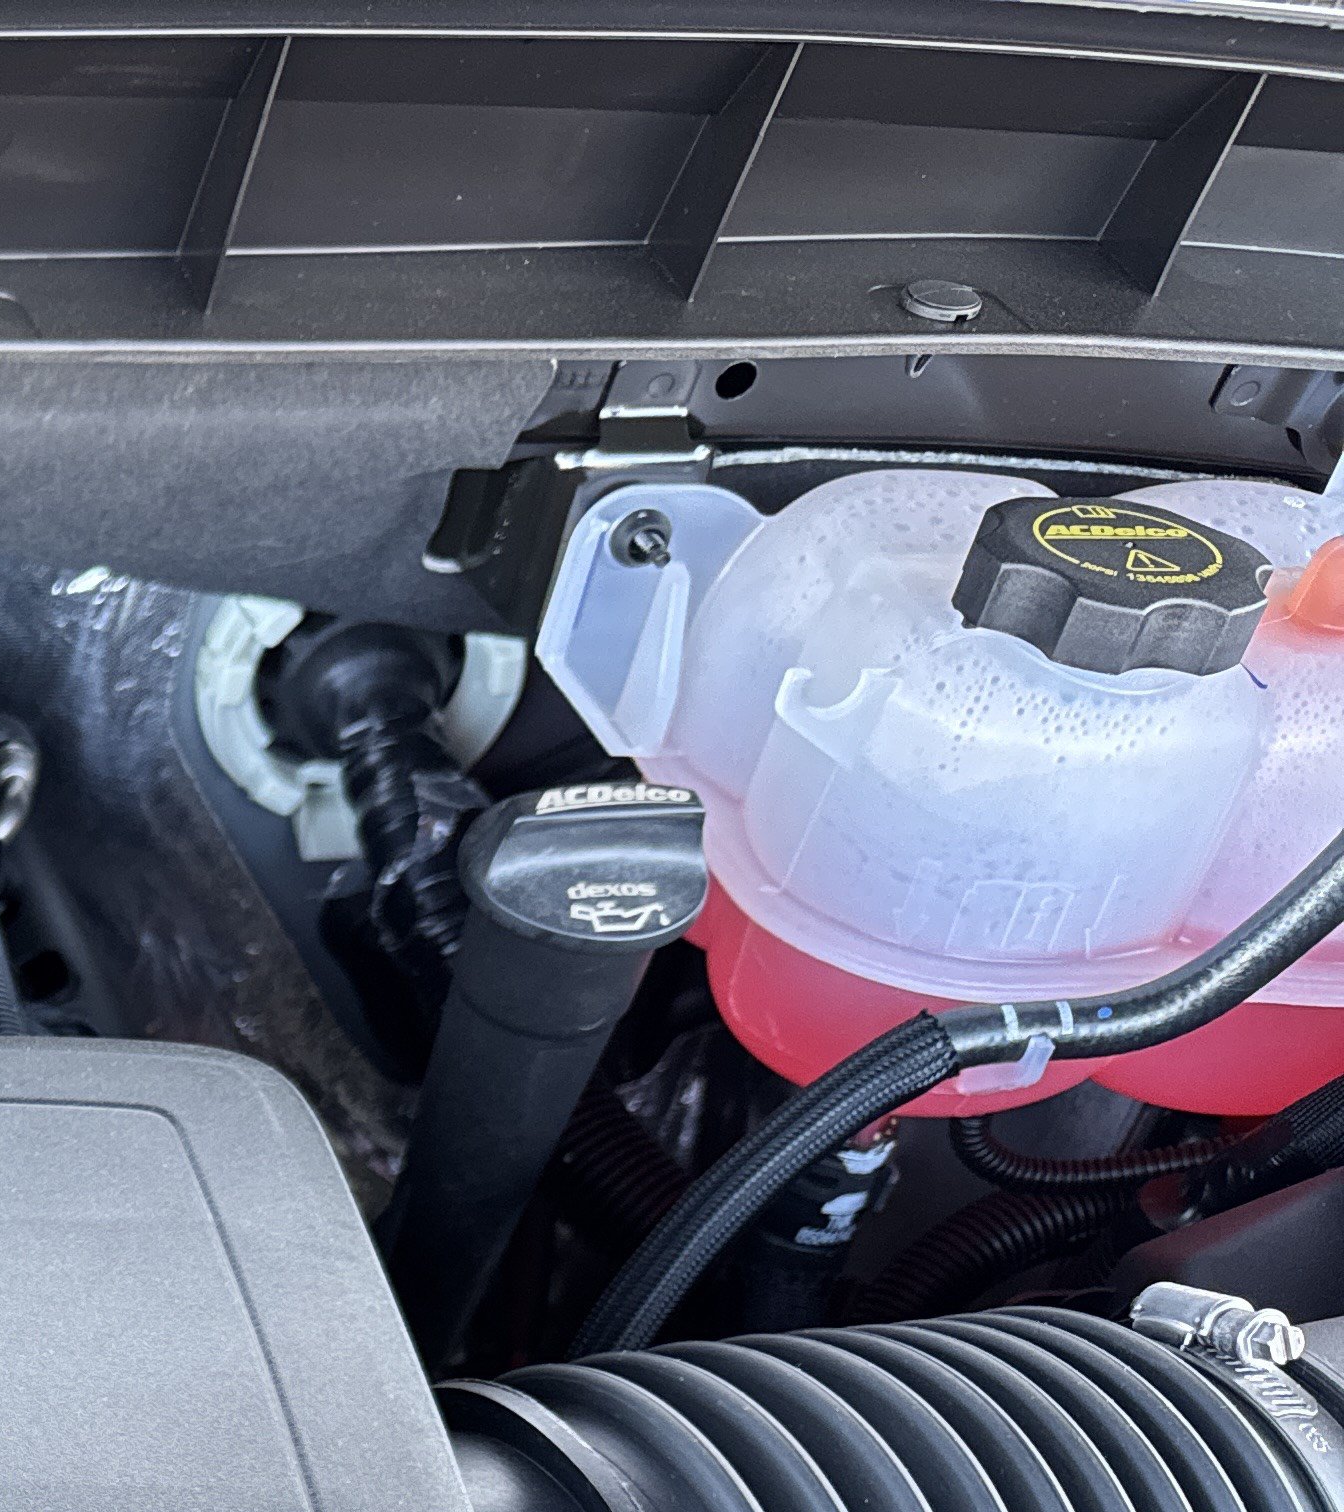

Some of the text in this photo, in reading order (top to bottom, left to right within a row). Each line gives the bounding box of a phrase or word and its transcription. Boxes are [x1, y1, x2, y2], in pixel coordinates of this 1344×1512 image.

[1045, 524, 1188, 538] ACDelco
[536, 783, 692, 812] ACDelco
[567, 880, 657, 899] dexos
